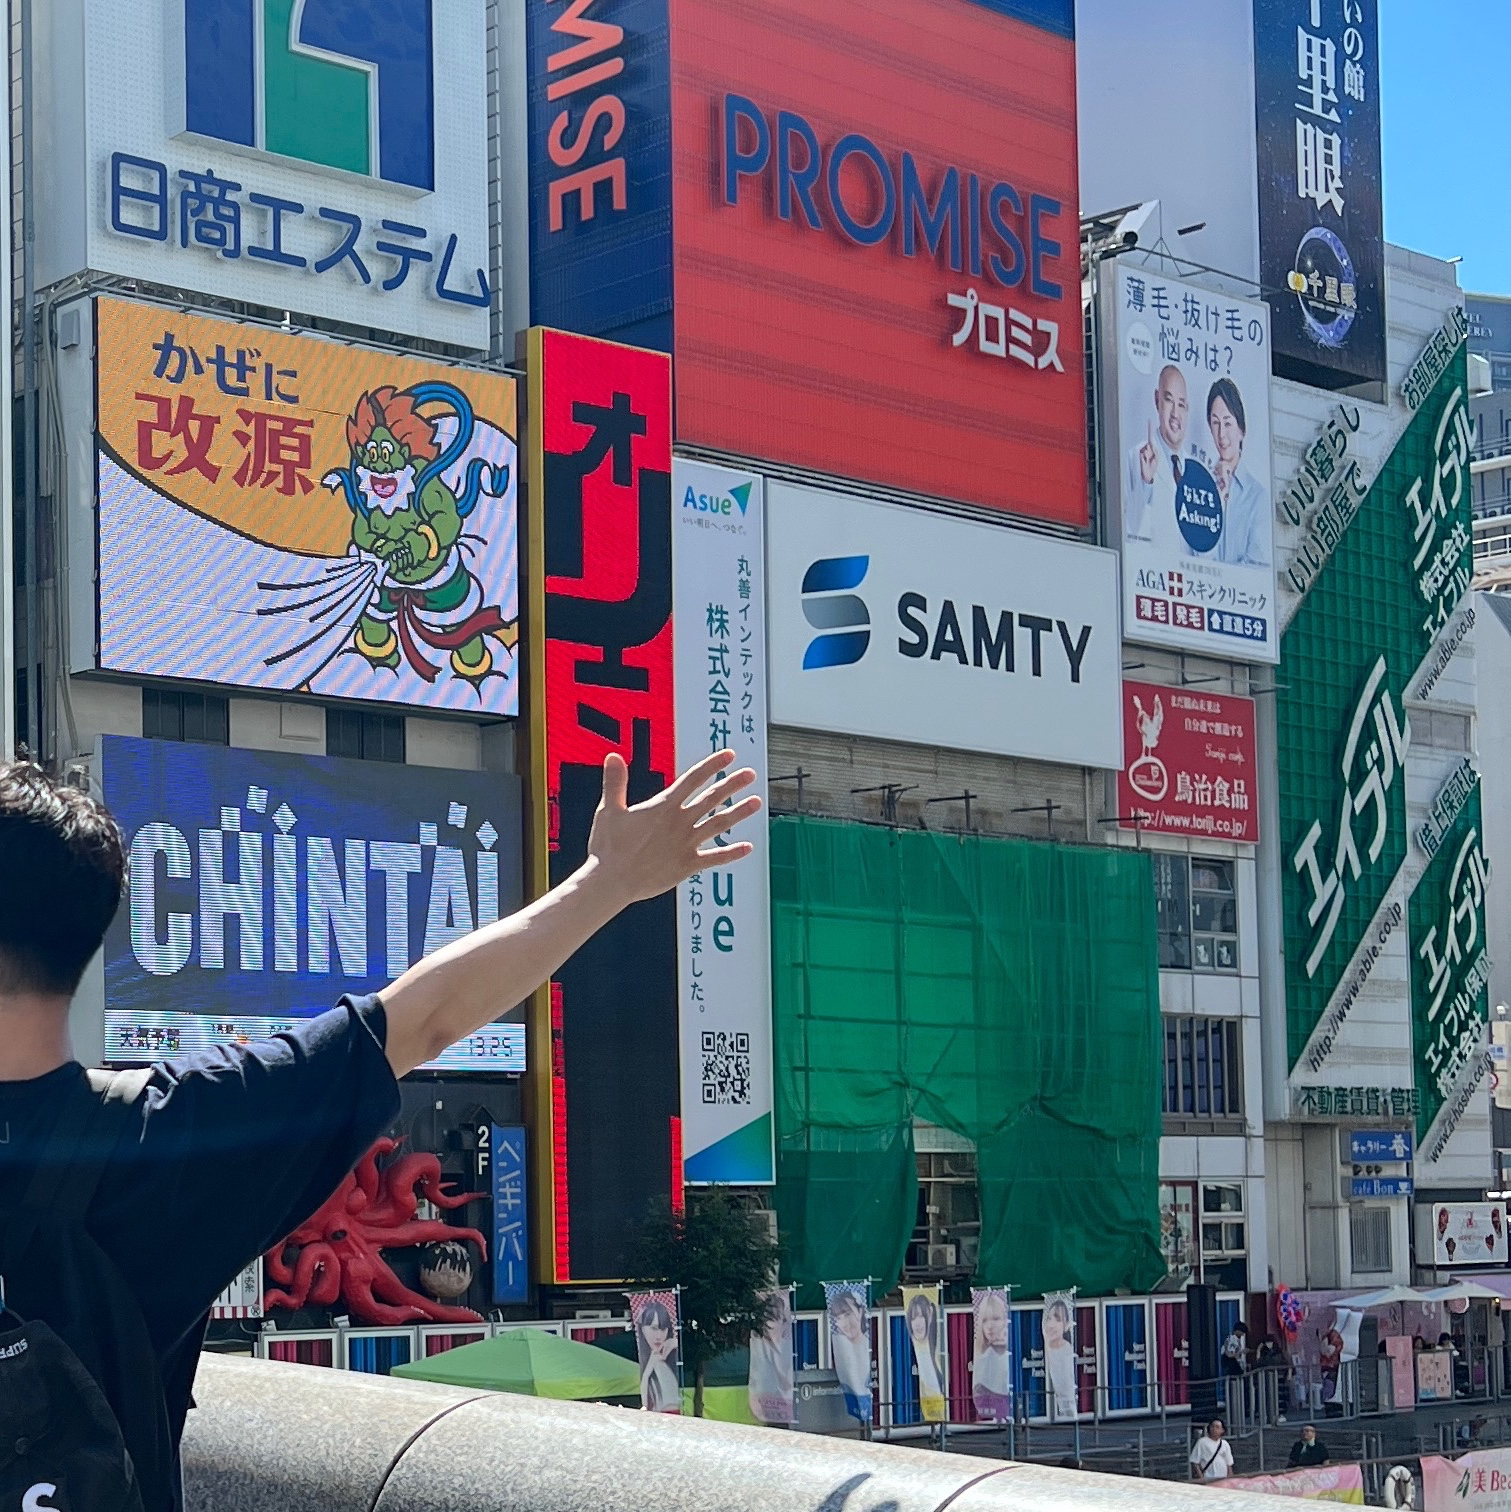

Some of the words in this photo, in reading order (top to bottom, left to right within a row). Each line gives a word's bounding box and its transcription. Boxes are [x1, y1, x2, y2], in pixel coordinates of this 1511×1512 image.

[111, 152, 489, 308] 日商エステム
[725, 92, 1063, 300] PROMISE
[947, 288, 1065, 373] プロミス
[1127, 276, 1264, 346] 薄毛・抜け毛の
[1403, 305, 1469, 412] お部屋探しは
[152, 332, 300, 404] かぜに
[135, 392, 314, 495] 改源
[1283, 404, 1359, 526] いい暮らし
[1406, 386, 1476, 571] エイブル
[683, 485, 732, 516] Asue
[1178, 507, 1220, 533] Asking!
[1289, 460, 1368, 594] いい部屋で
[1136, 569, 1166, 591] AGA
[1186, 580, 1266, 611] スキンクリニック
[737, 555, 755, 744] 丸善インテックは、
[898, 592, 1092, 683] SAMTY
[1417, 607, 1476, 701] www.able.co.jp
[1294, 655, 1411, 978] エイブル
[129, 808, 499, 977] CHINTAI
[1430, 827, 1491, 1021] エイブル
[477, 1125, 489, 1175] 2F
[1374, 1179, 1394, 1194] Bon
[497, 1139, 523, 1286] ペンギンバー
[1473, 1467, 1486, 1493] 美
